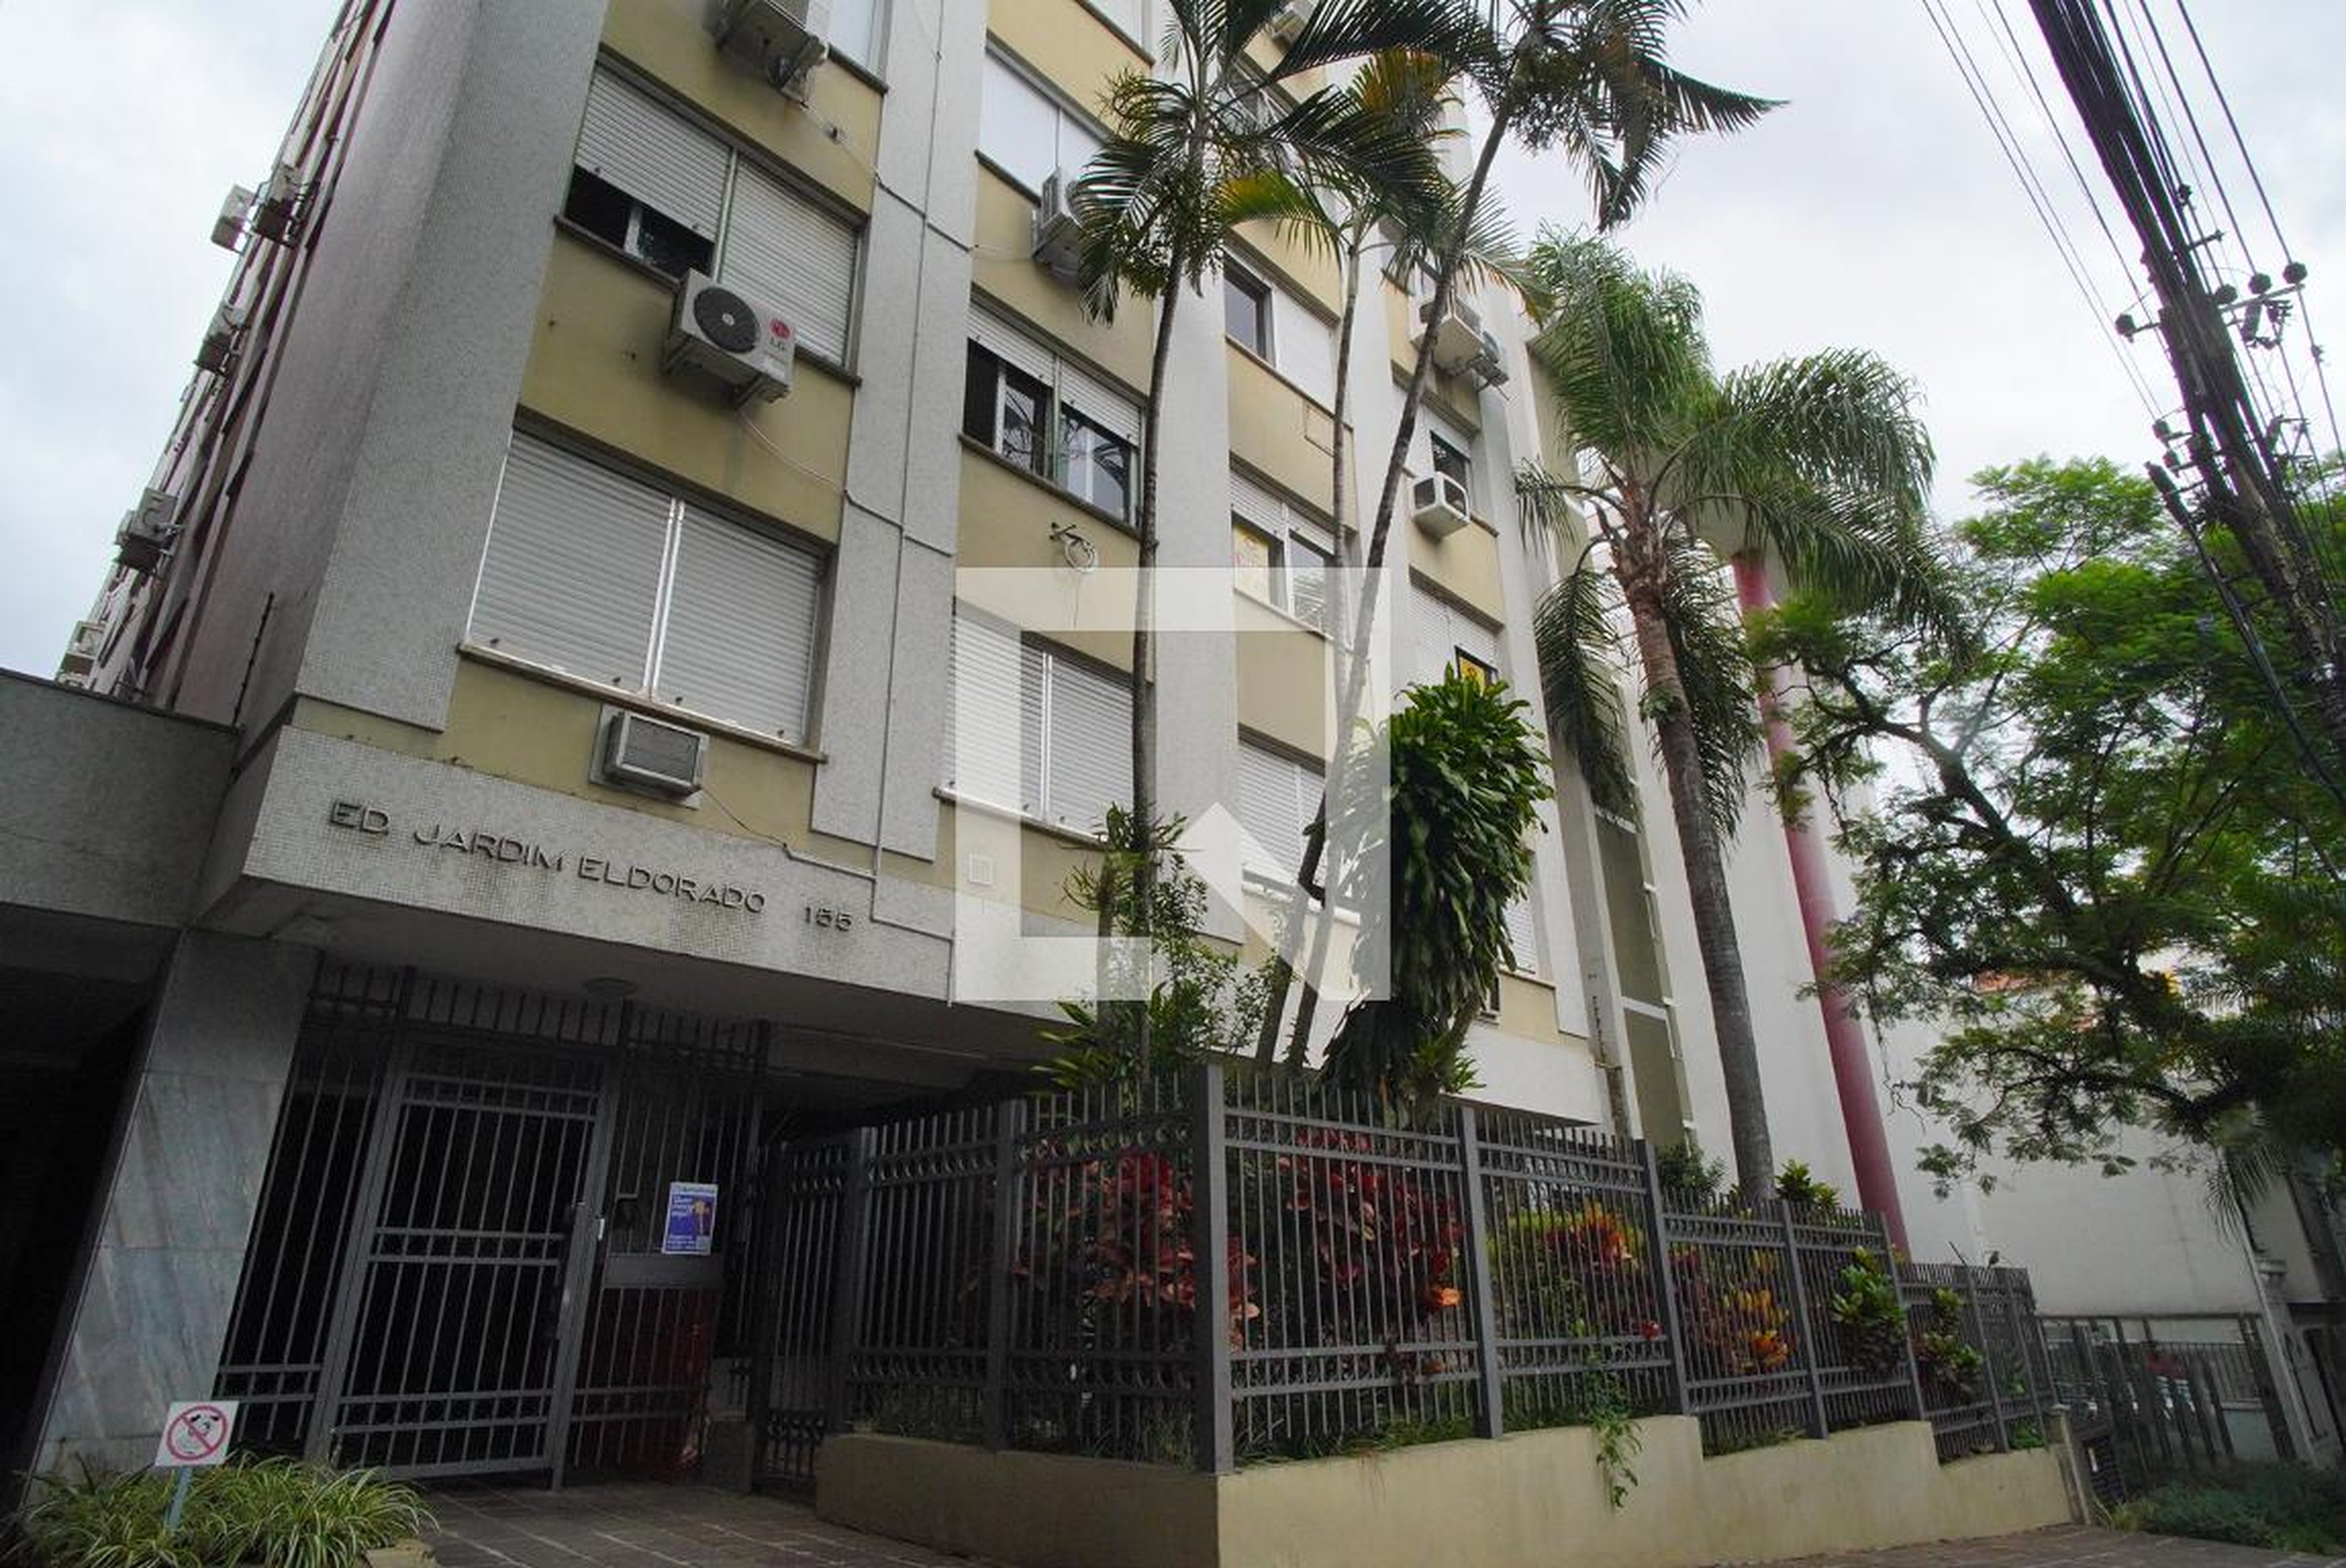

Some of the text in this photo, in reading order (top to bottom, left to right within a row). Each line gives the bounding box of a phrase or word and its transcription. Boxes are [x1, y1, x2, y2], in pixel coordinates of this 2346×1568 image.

[331, 800, 389, 836] ED
[414, 824, 563, 872] JARDIM
[577, 856, 765, 913] ELDORADO
